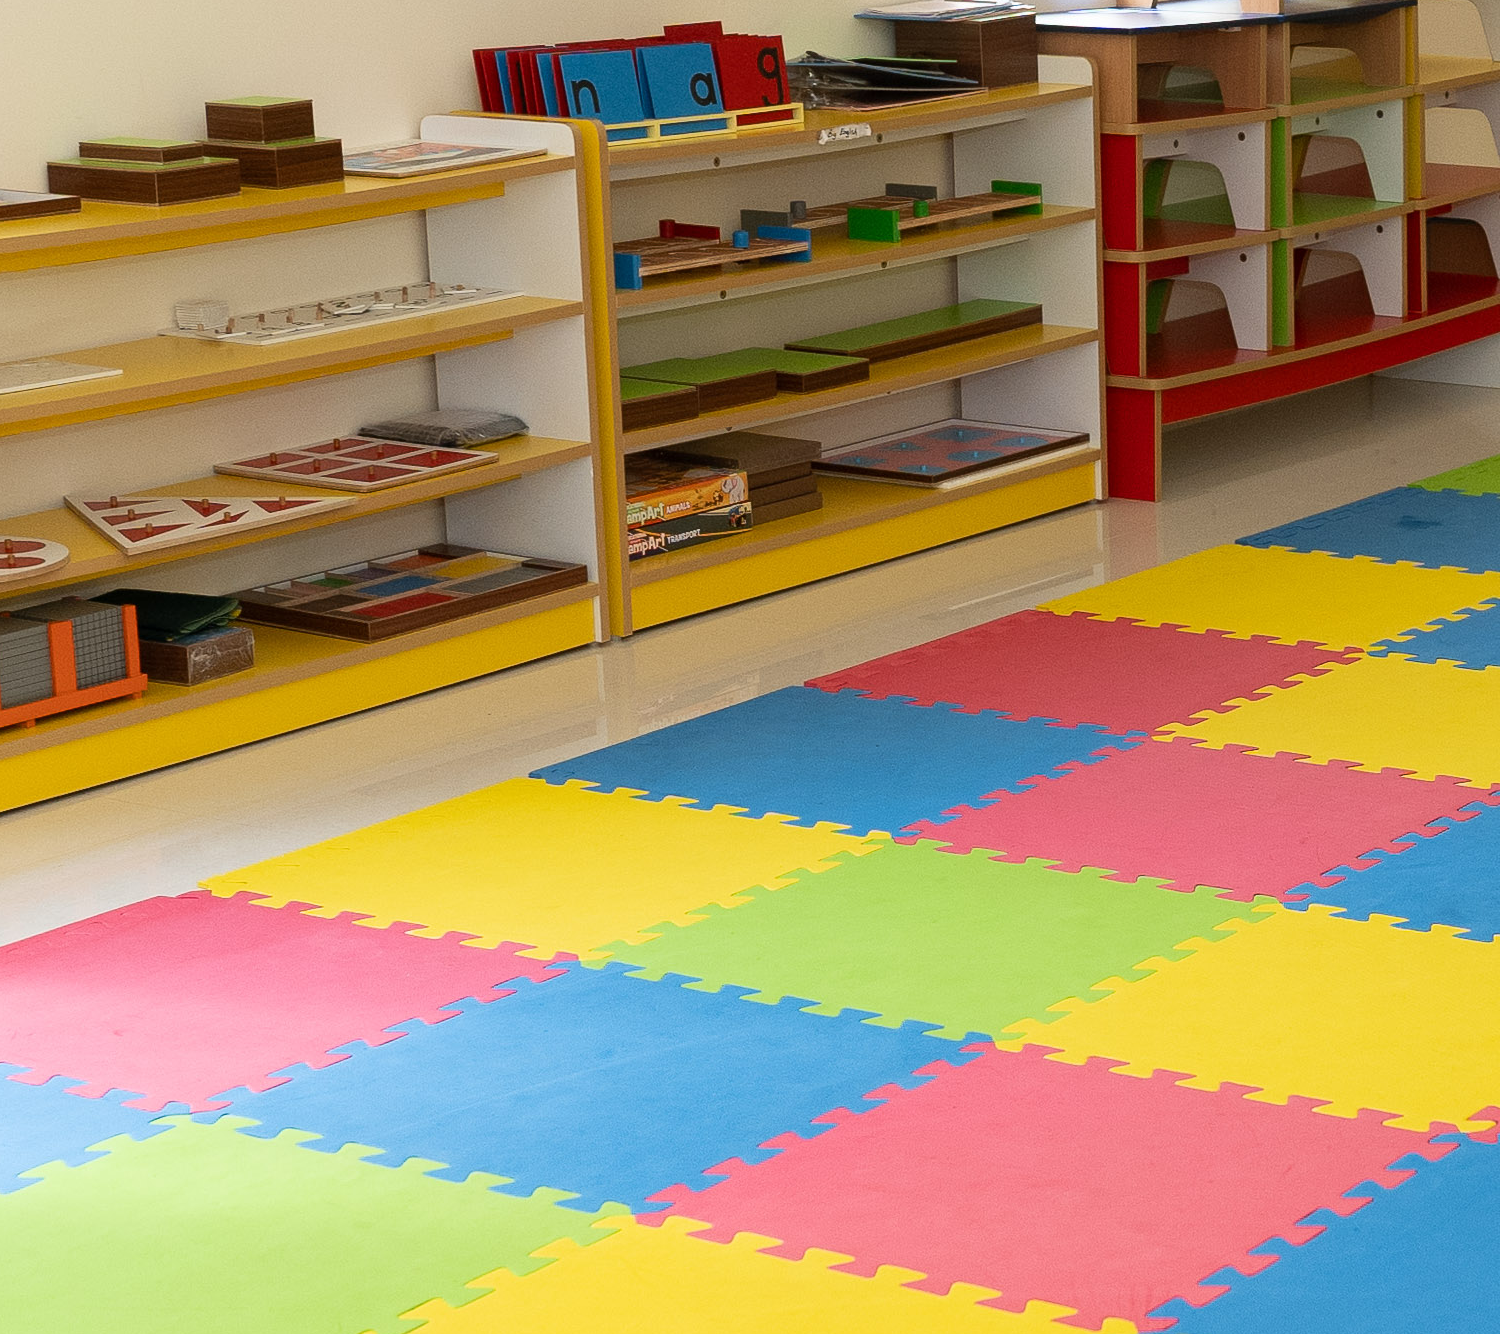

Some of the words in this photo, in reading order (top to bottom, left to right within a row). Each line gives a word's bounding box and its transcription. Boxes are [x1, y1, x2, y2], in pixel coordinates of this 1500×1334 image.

[689, 72, 718, 107] a
[756, 46, 783, 107] g
[570, 78, 601, 116] n
[666, 501, 691, 515] ANIMALS
[667, 528, 701, 545] TRANSPORT
